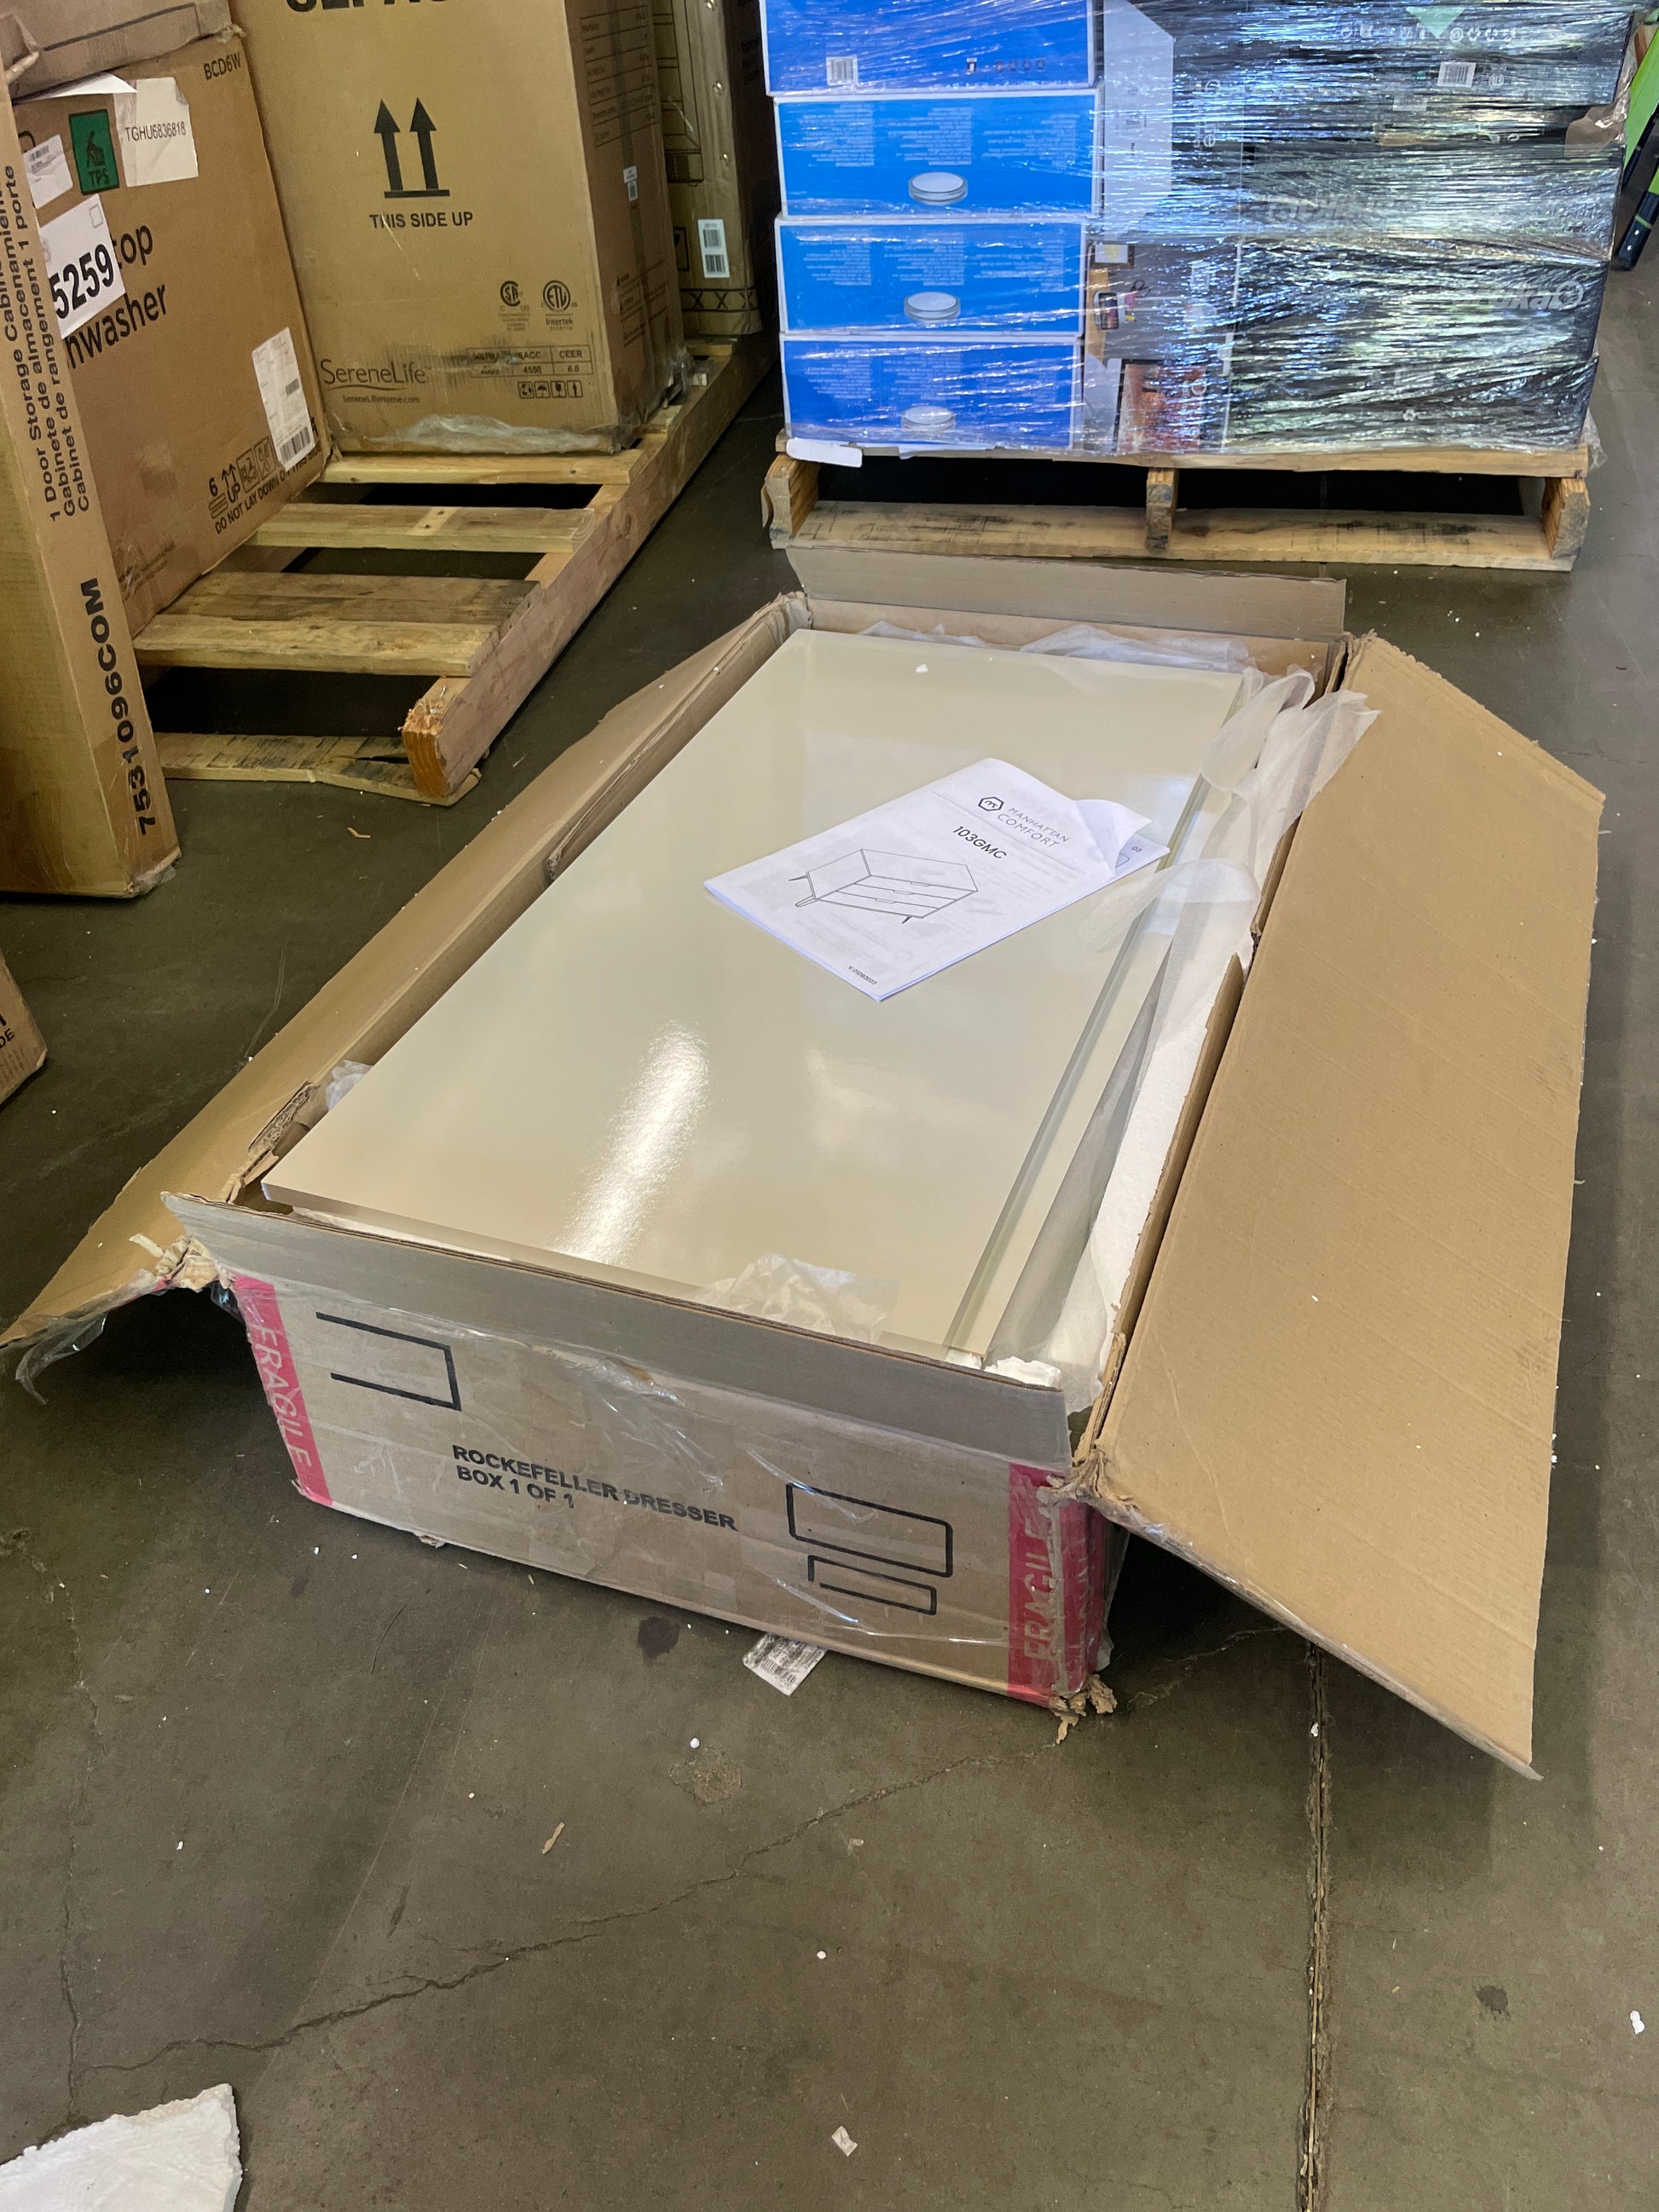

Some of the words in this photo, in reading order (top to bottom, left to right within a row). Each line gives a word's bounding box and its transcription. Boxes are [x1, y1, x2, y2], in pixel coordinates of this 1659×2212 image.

[204, 52, 240, 80] BCD6W
[124, 121, 187, 141] TGHU6836818
[5, 165, 28, 229] porte
[369, 213, 406, 228] THIS
[410, 212, 448, 228] SIDE
[452, 211, 473, 226] UP
[49, 244, 114, 320] 5259
[23, 257, 61, 385] rangement
[321, 358, 425, 384] SereneLife
[558, 349, 583, 358] CEER
[14, 349, 42, 441] Storage
[38, 381, 50, 410] de
[55, 391, 69, 419] de
[37, 447, 57, 502] Door
[46, 417, 76, 517] Gabinete
[62, 425, 90, 511] Cabinet
[215, 517, 228, 534] DO
[228, 503, 243, 524] NOT
[244, 493, 258, 511] LAY
[257, 476, 280, 500] DOWN
[227, 482, 241, 504] UP
[50, 511, 61, 521] 1
[81, 578, 156, 835] 7531096COM
[953, 825, 1007, 858] 103GMC
[997, 813, 1060, 847] COMFORT
[1008, 807, 1070, 842] MANHATTAN
[251, 1324, 311, 1468] FRAGILE
[452, 1444, 620, 1501] ROCKEFELLER
[623, 1489, 738, 1532] DRESSER
[456, 1464, 505, 1490] BOX
[509, 1478, 521, 1495] 1
[527, 1483, 557, 1504] OF
[564, 1493, 575, 1509] 1
